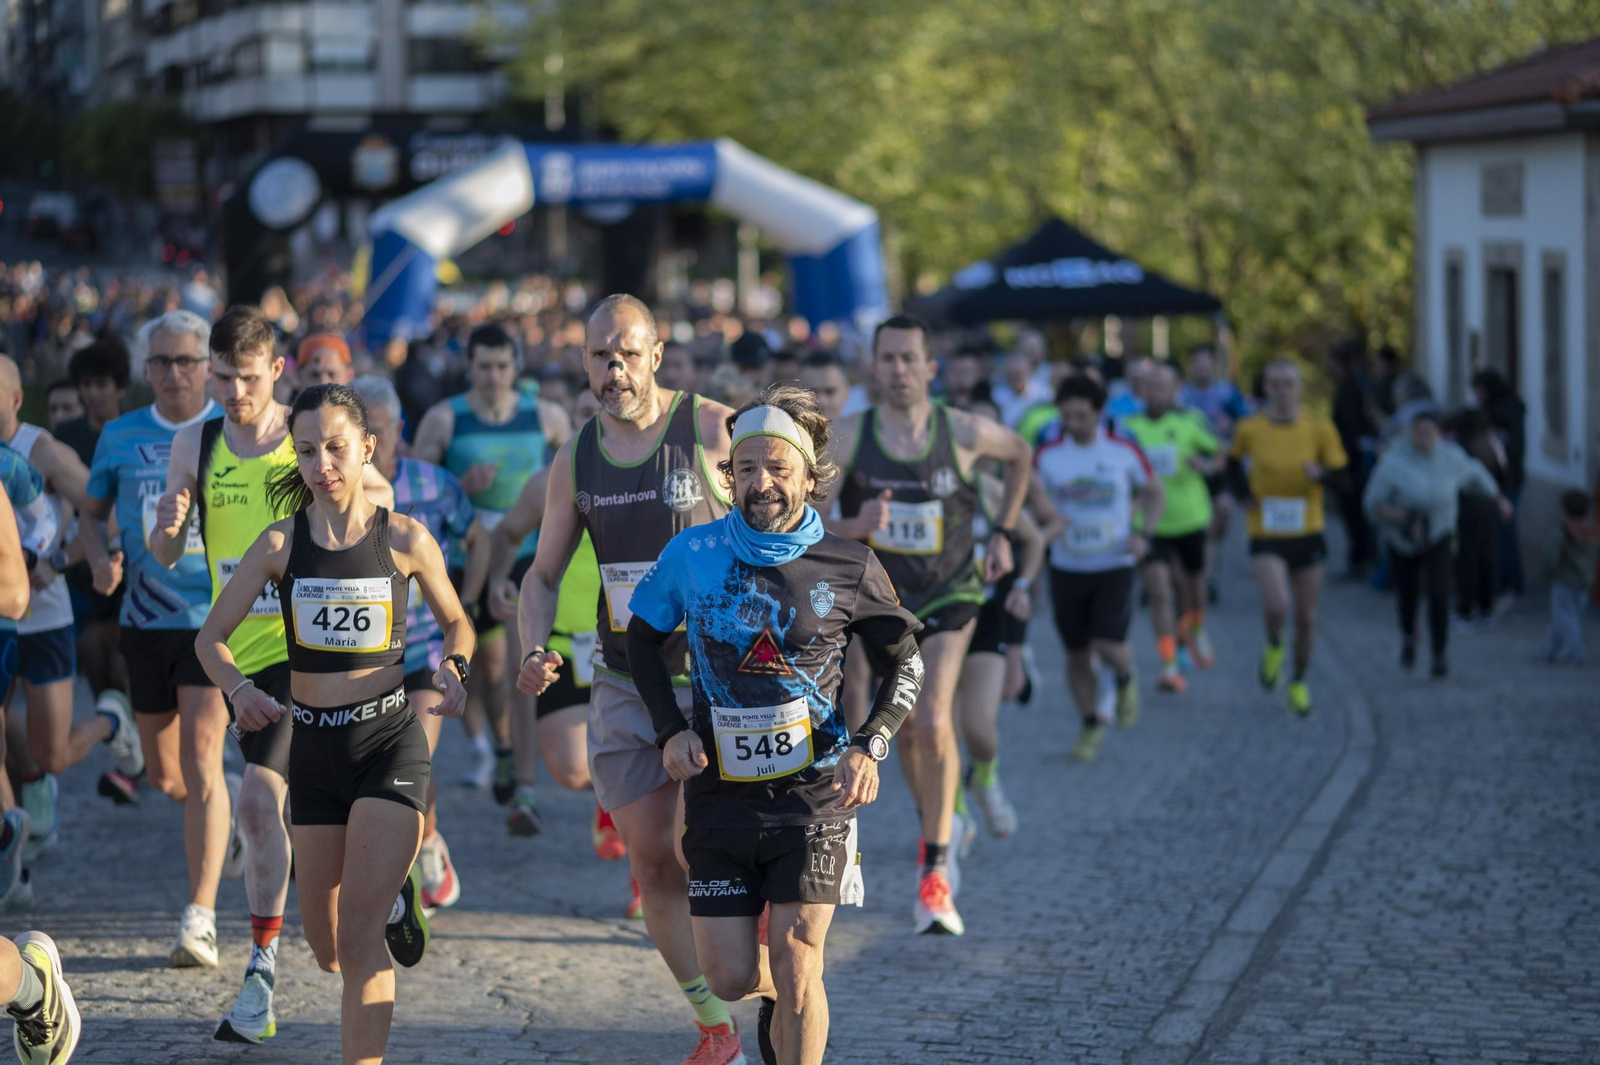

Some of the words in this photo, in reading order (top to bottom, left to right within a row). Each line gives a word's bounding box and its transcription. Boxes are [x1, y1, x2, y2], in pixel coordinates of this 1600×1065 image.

[593, 489, 657, 507] Dentalnova
[887, 521, 926, 539] 118
[312, 606, 371, 632] 426
[324, 637, 357, 647] María
[318, 700, 378, 727] NIKE
[381, 687, 406, 714] PR
[734, 732, 793, 761] 548
[756, 763, 776, 777] Juli
[688, 886, 749, 898] UINTANA
